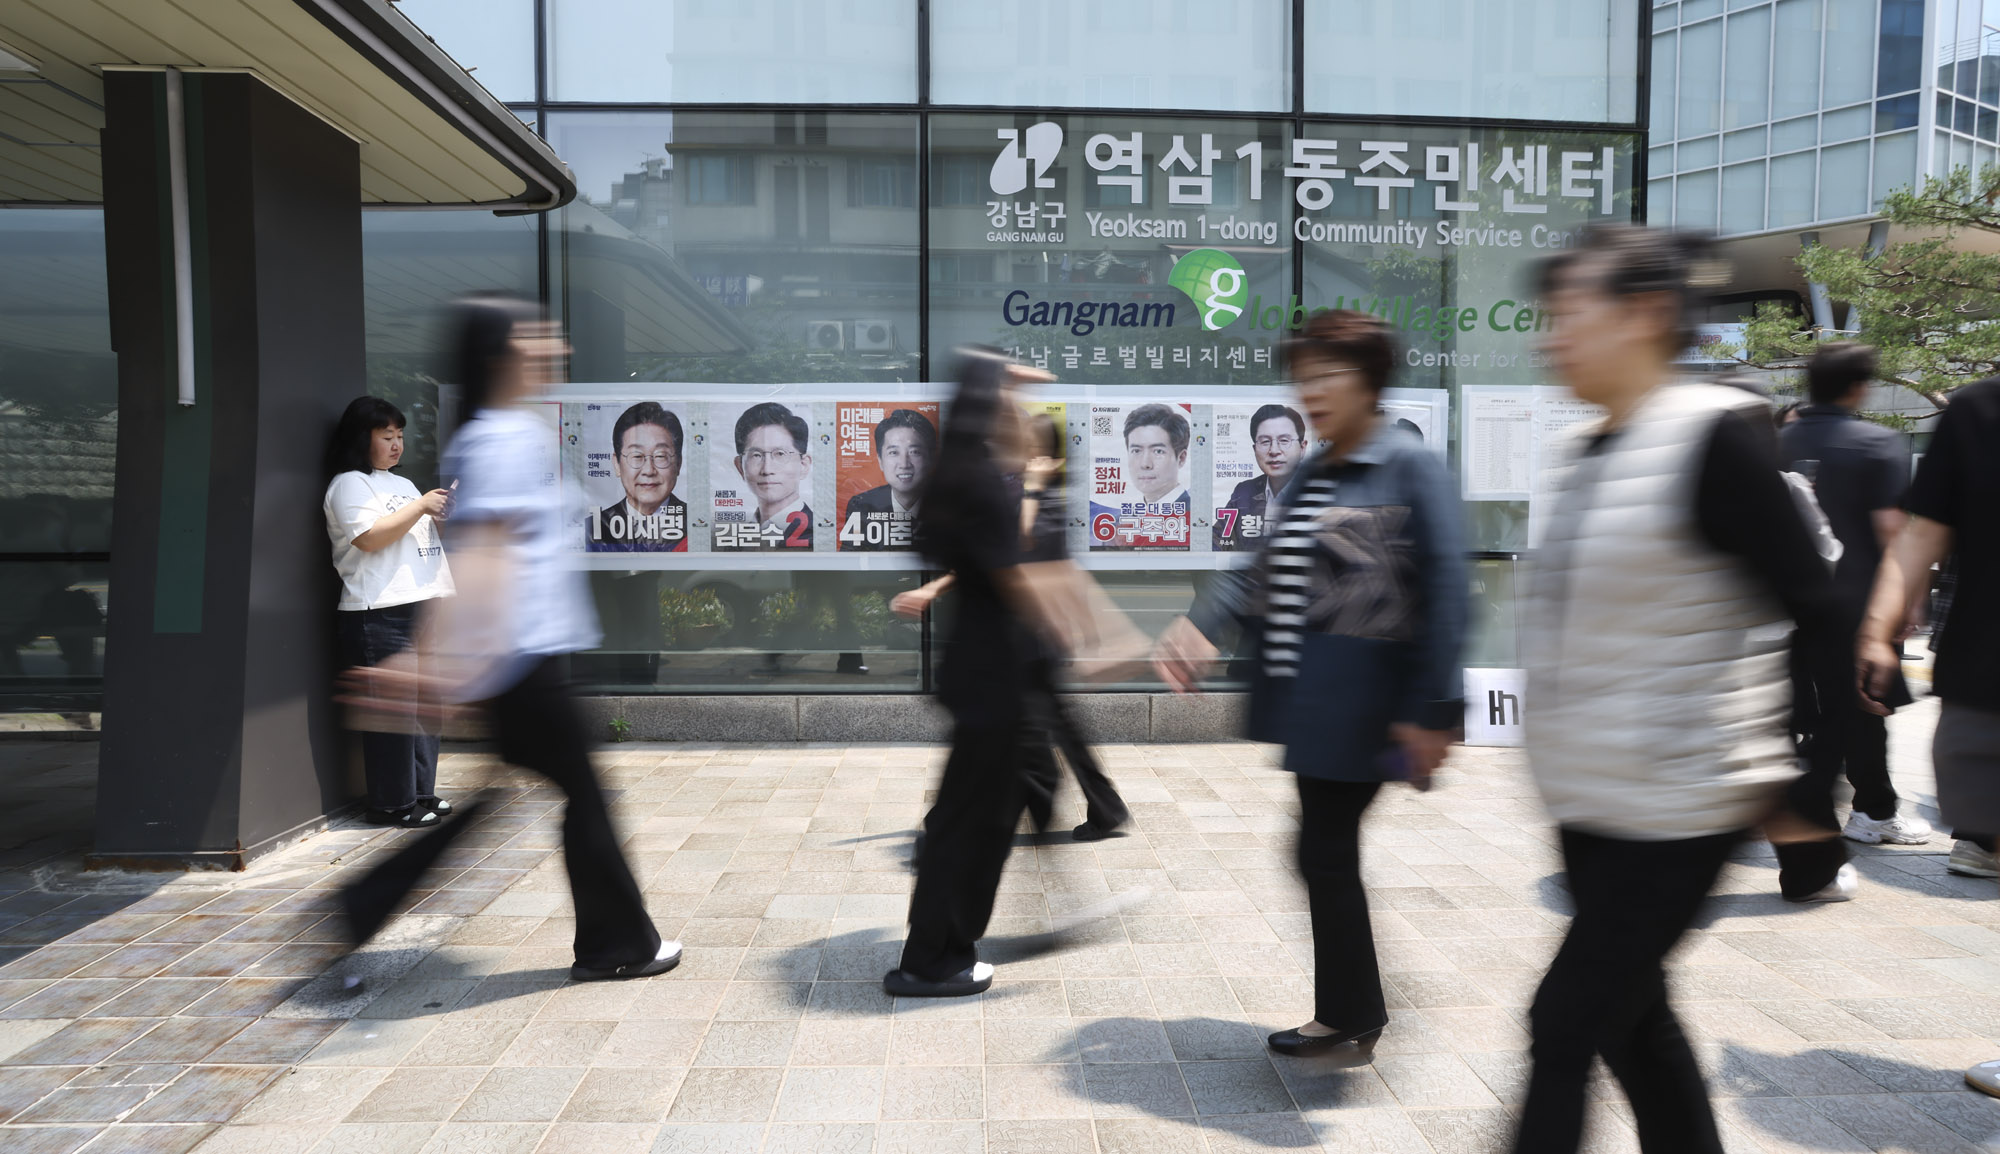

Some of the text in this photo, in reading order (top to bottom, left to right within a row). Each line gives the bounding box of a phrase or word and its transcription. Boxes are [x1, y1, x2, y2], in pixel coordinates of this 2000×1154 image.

[1085, 131, 1614, 215] 역삼1동주민센터
[986, 201, 1067, 229] 강남구
[986, 231, 1064, 243] GANG NAM GU
[1085, 212, 1187, 239] Yeoksam
[1197, 215, 1278, 244] 1-dong
[1294, 217, 1428, 249] Community
[1436, 220, 1523, 247] Service
[1003, 290, 1176, 337] Gangnam
[1406, 348, 1481, 368] Center
[1489, 349, 1518, 368] for
[840, 407, 885, 424] 미래를
[840, 424, 870, 440] 여는
[840, 440, 870, 456] 선택
[1095, 466, 1121, 480] 정치
[715, 490, 736, 498] 새롭게
[1095, 481, 1126, 494] 교체!
[715, 498, 743, 507] 대한민국
[1121, 502, 1185, 515] 젊은 대통령
[589, 506, 684, 540] 1 이재명
[716, 511, 745, 521] 정정당당
[867, 512, 889, 520] 새로운
[1216, 508, 1239, 538] 7
[714, 510, 810, 547] 김문수 2
[839, 511, 865, 547] 4
[1092, 512, 1190, 542] 6 구주와
